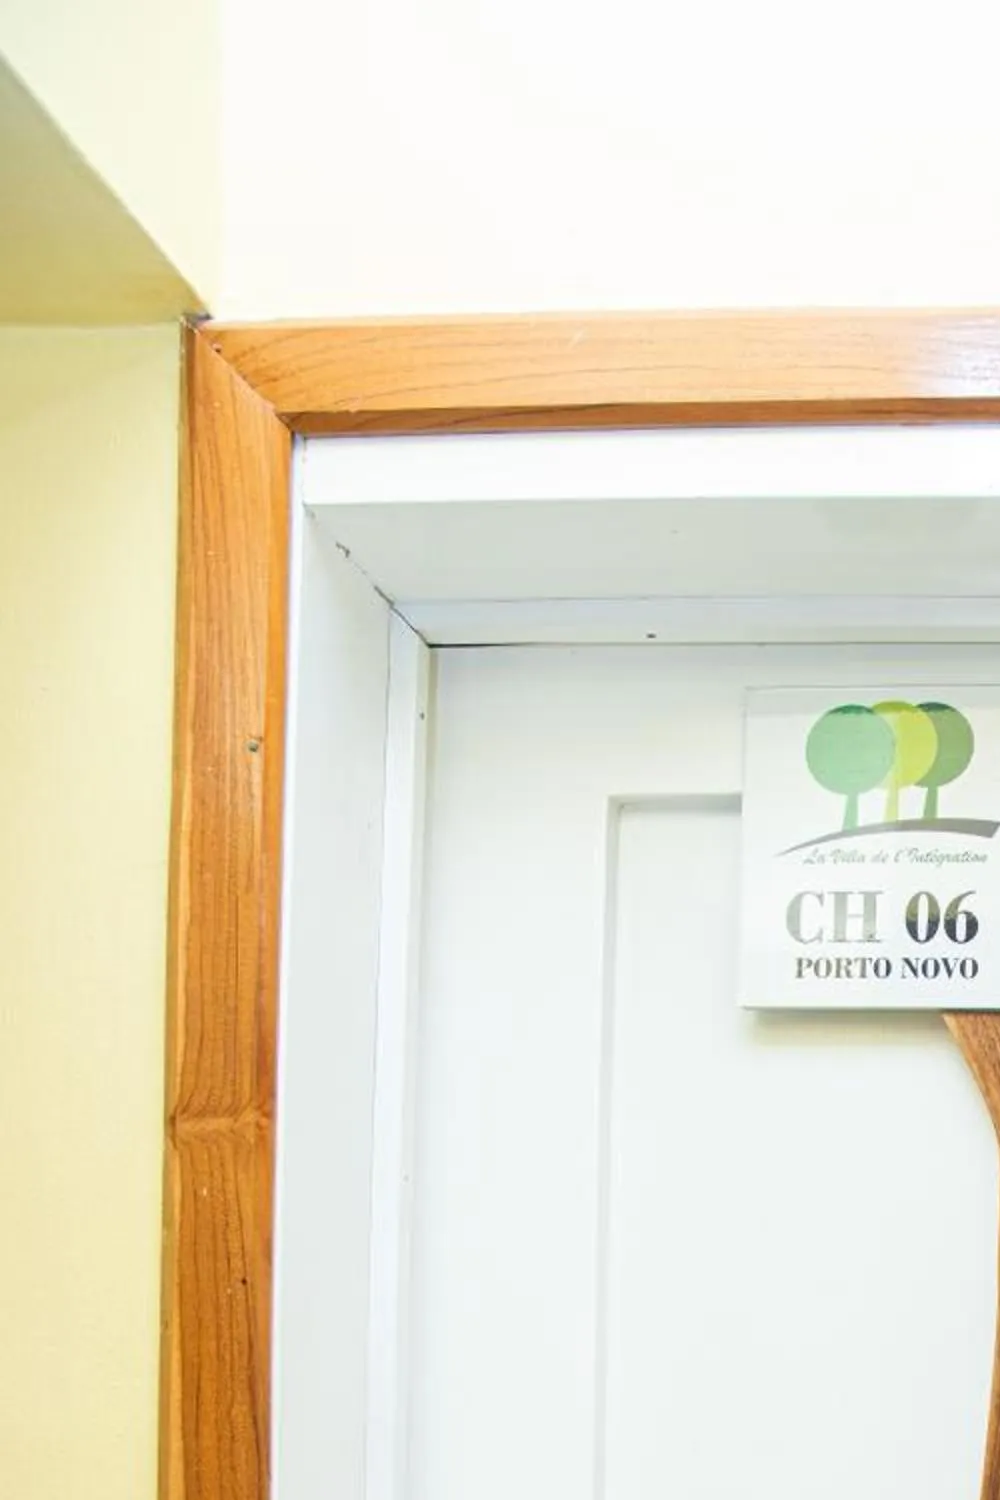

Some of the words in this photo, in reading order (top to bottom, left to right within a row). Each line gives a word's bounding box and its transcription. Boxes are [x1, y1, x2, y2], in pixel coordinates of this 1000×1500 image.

[803, 848, 826, 865] La
[870, 849, 890, 864] de
[786, 890, 885, 945] CH
[905, 890, 980, 945] 06
[795, 957, 893, 979] PORTO
[900, 957, 980, 980] NOVO
